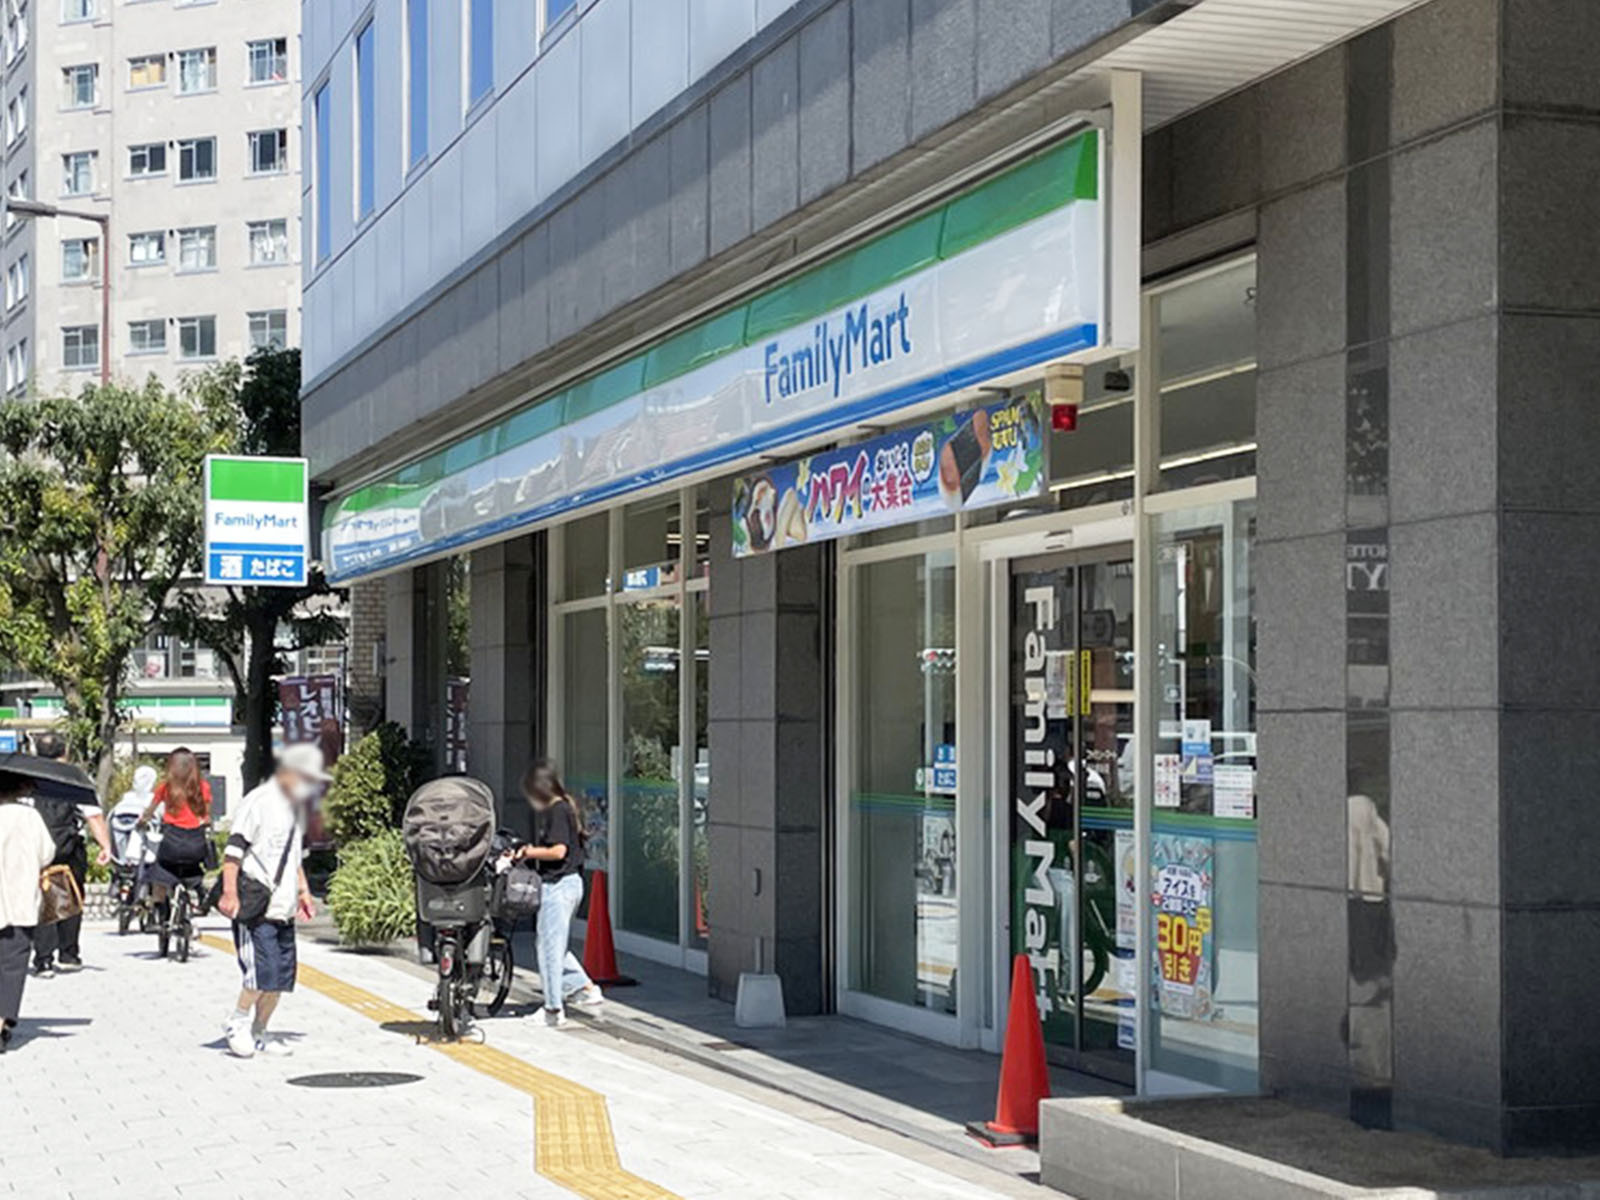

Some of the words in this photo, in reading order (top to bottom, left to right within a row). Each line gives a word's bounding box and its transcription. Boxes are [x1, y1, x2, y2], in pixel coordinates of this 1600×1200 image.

[764, 292, 911, 404] FamilyMart
[871, 470, 912, 512] 大集合
[214, 512, 297, 529] FamilyMart
[250, 557, 295, 578] たばこ
[1017, 585, 1056, 1021] FamilyMart
[1157, 913, 1203, 957] 30円
[1164, 953, 1192, 983] 引き
